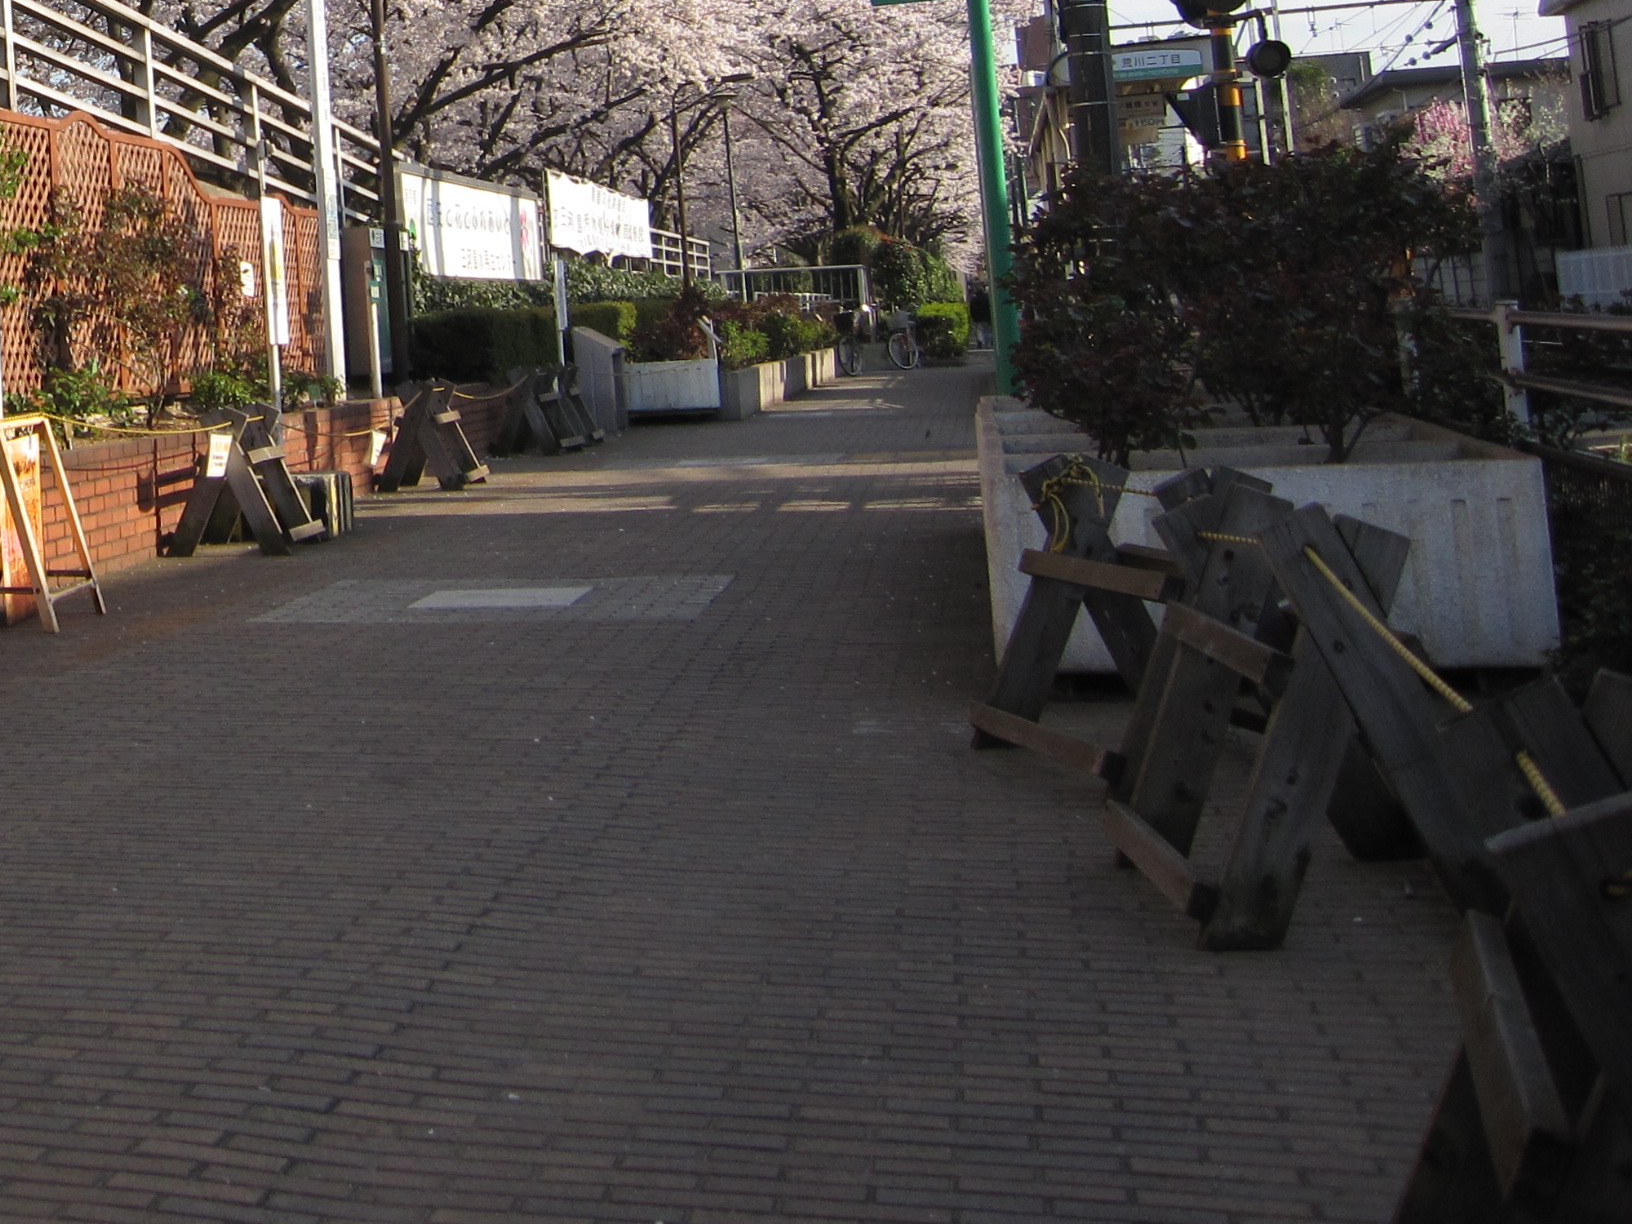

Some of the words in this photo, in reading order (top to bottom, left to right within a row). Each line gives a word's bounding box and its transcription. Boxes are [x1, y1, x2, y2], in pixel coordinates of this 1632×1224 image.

[1121, 53, 1181, 68] 荒川二丁目
